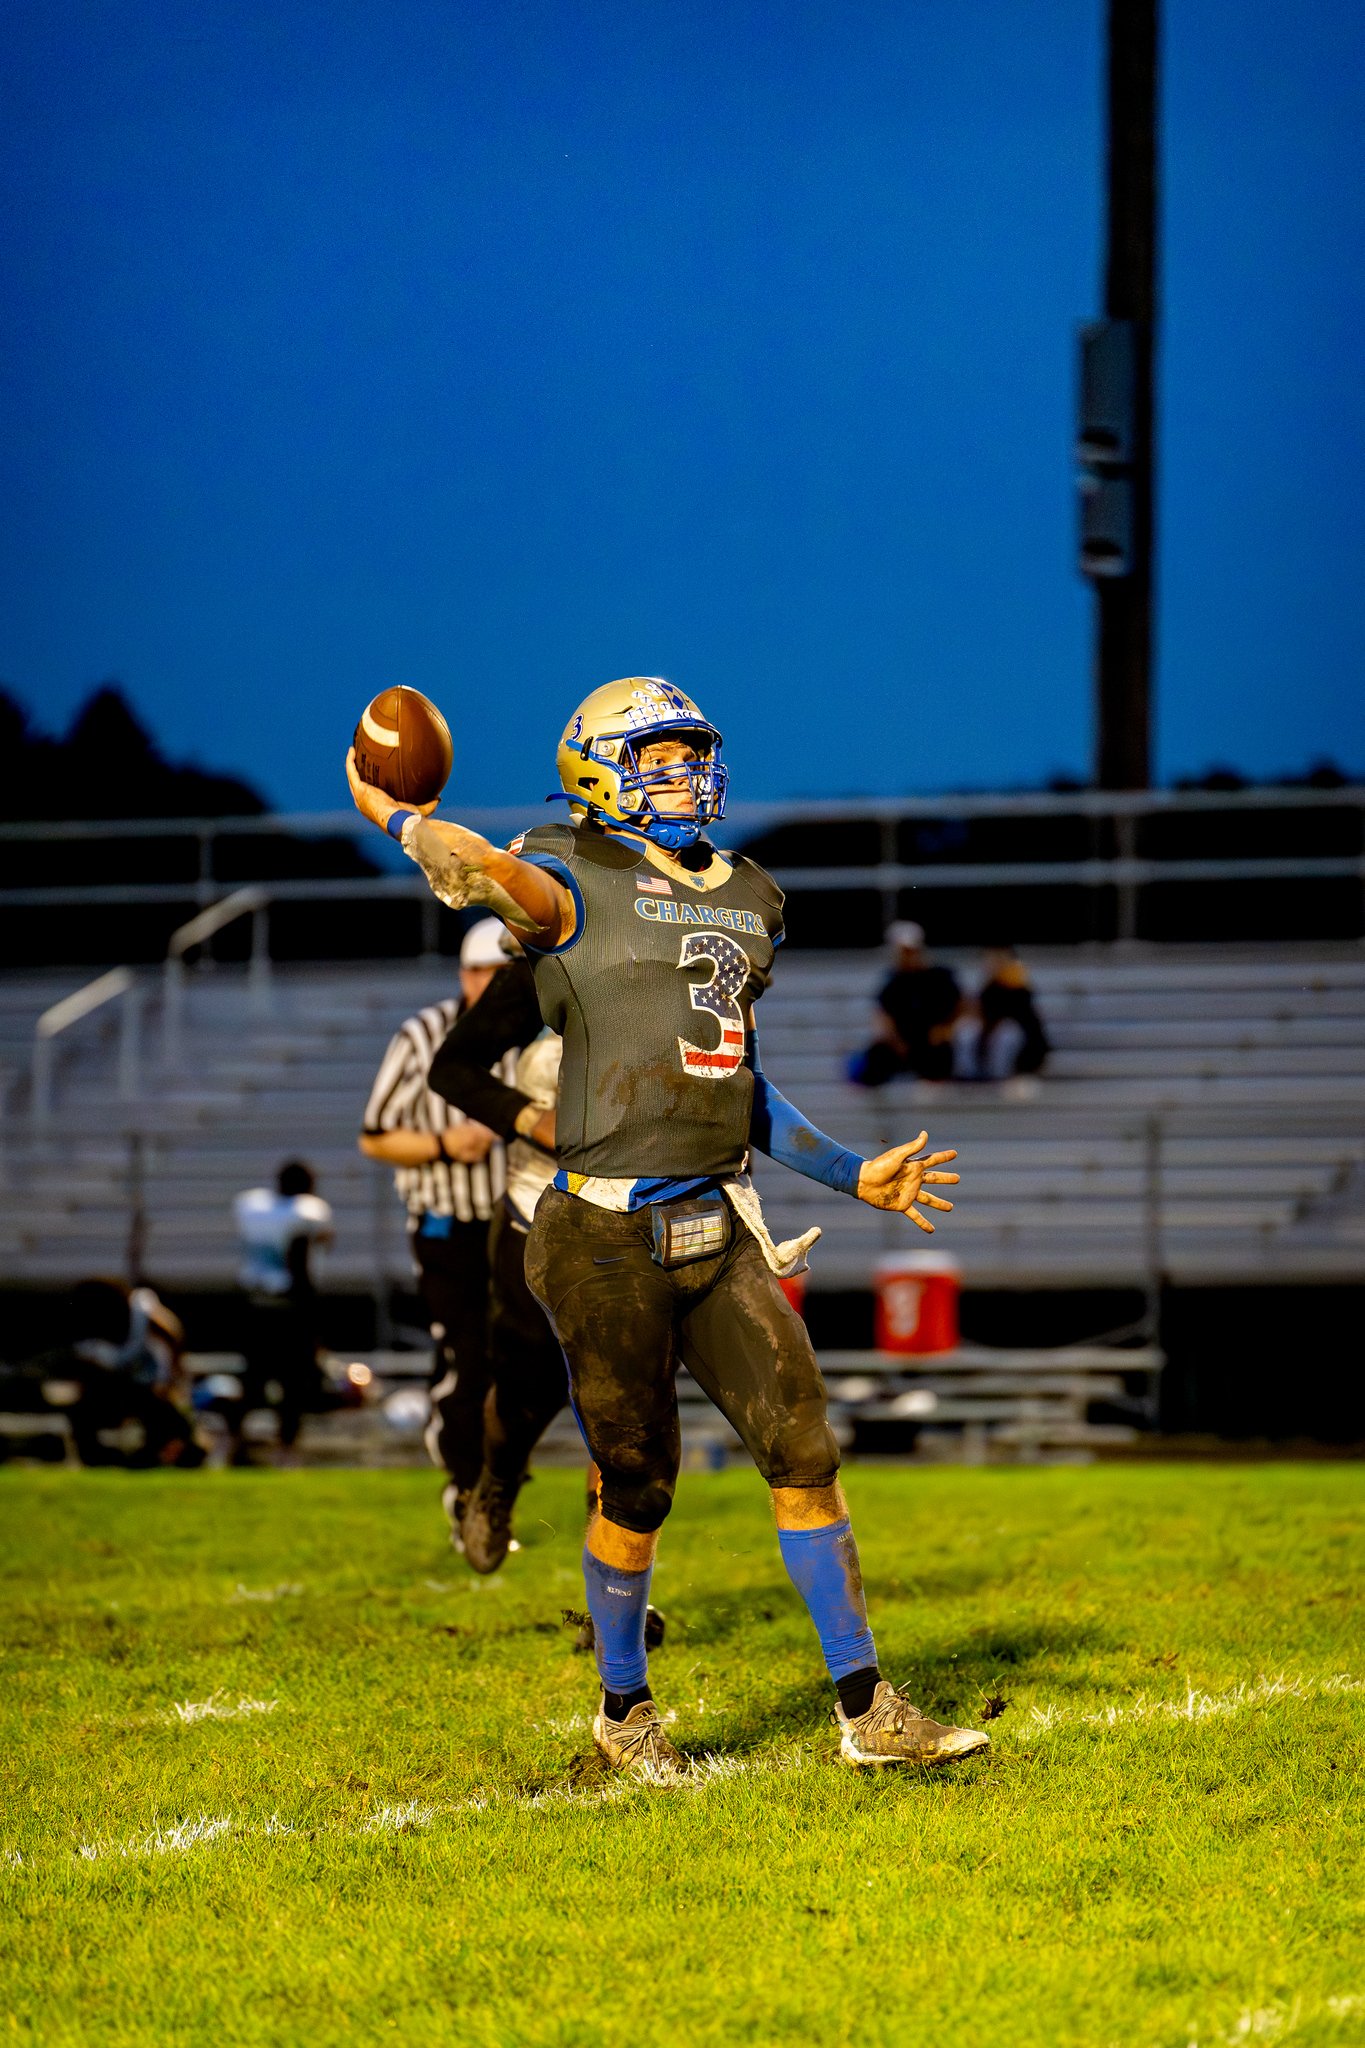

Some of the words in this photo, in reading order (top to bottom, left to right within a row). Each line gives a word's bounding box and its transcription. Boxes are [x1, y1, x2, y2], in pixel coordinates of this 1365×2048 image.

[571, 714, 583, 740] 3
[634, 897, 769, 937] CHARGERS
[676, 931, 751, 1079] 3
